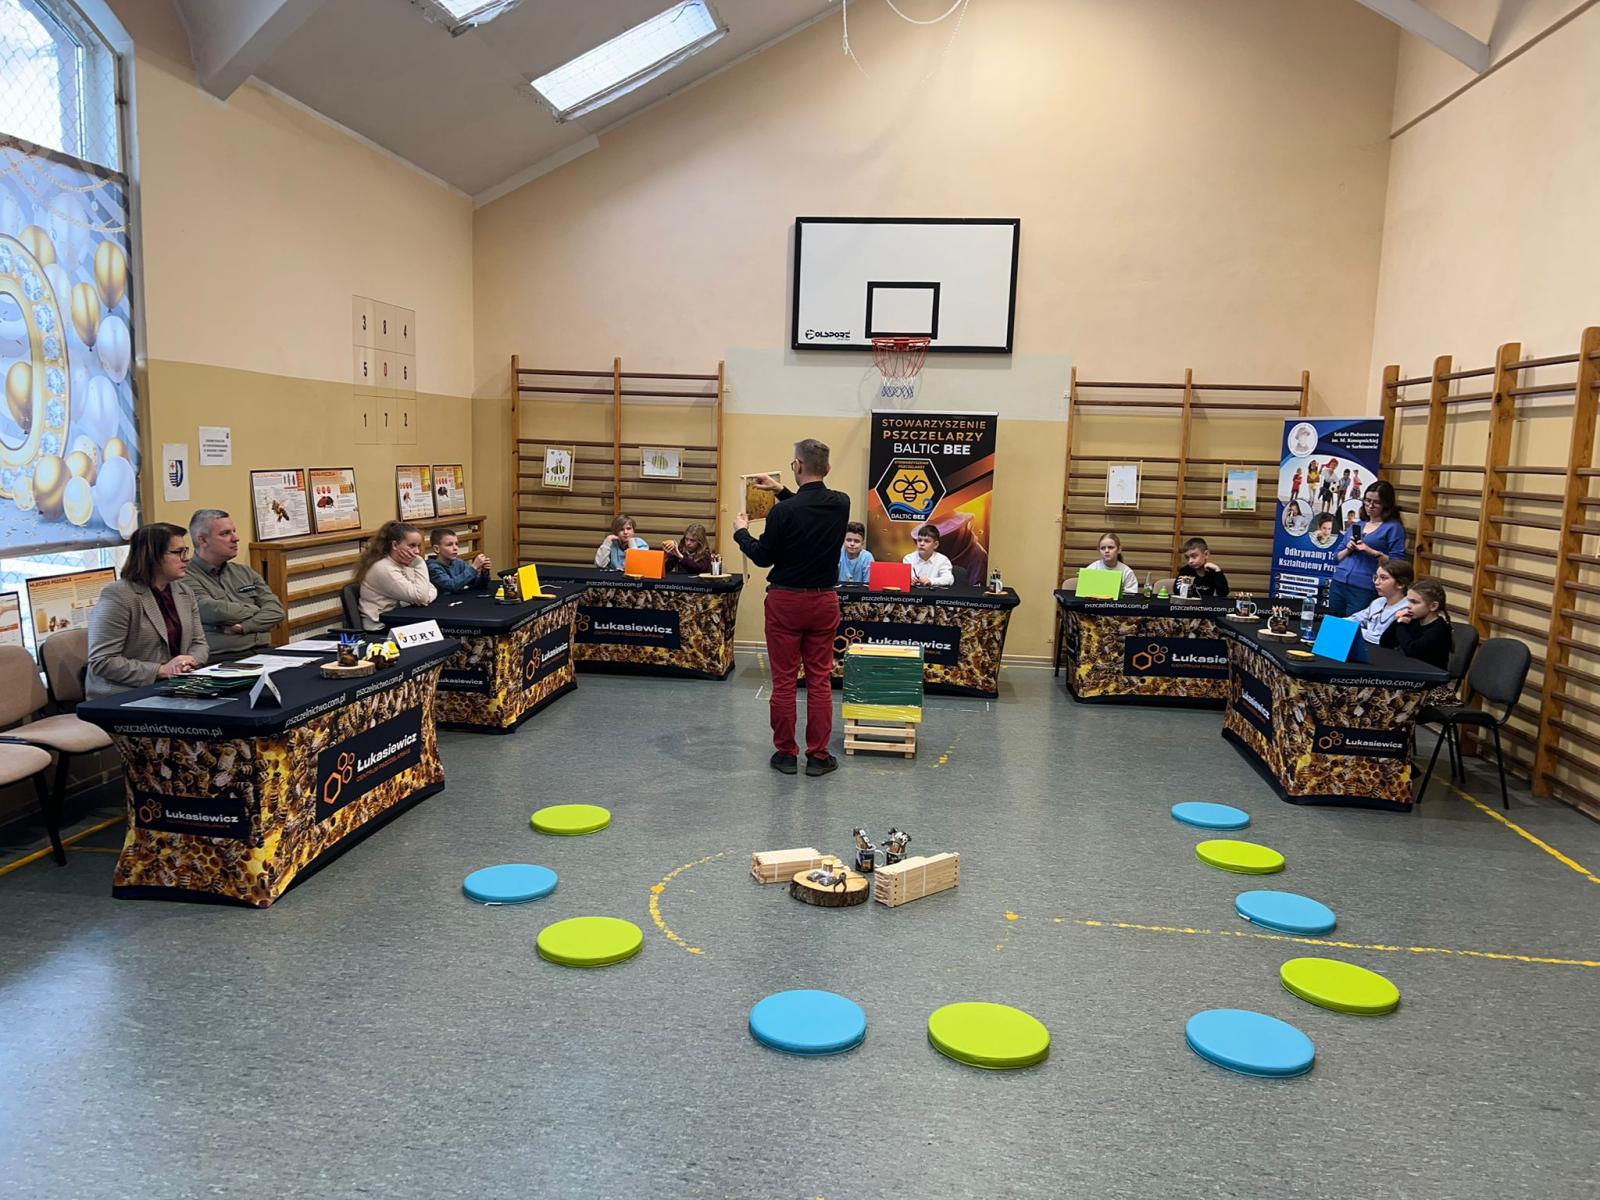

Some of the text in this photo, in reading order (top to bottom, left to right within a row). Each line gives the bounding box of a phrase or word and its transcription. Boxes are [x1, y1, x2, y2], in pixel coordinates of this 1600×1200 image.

[362, 314, 367, 331] 3
[363, 361, 368, 377] 5
[363, 412, 367, 427] 1
[404, 412, 408, 427] 2
[882, 418, 987, 430] STOWARZYSZENIE
[883, 430, 983, 442] PSZCZELARZY
[893, 442, 971, 455] BALTIC BEE
[1284, 546, 1327, 560] Odkrywamy
[861, 595, 923, 604] pszczelnictwo.com.pl
[594, 621, 673, 634] Łukasiewicz
[402, 630, 435, 643] JURY
[1172, 653, 1230, 665] Łukasie
[1329, 677, 1426, 688] pszczelnictwo.com.pl
[285, 693, 347, 729] pszczelnictwo.com.pl
[113, 723, 223, 737] pszczelnictwo.com.pl
[1345, 738, 1403, 749] Łukasiewicz
[356, 732, 418, 773] Łukasiewicz
[165, 809, 240, 823] Łukasiewicz
